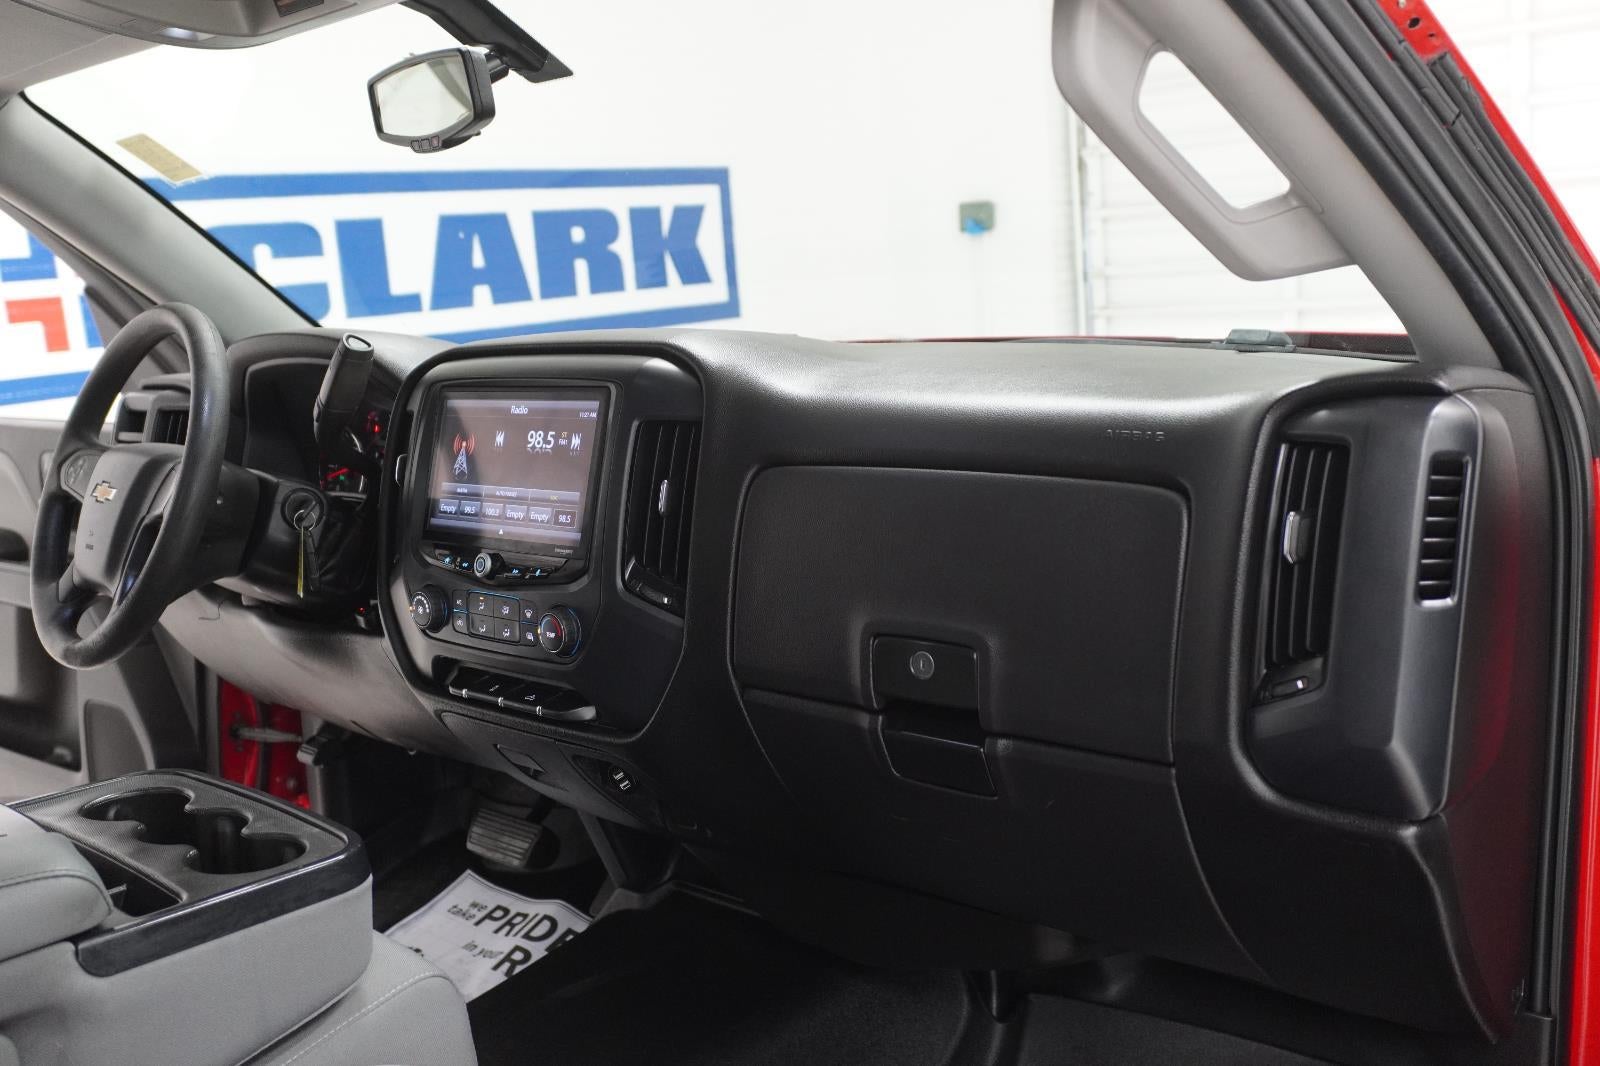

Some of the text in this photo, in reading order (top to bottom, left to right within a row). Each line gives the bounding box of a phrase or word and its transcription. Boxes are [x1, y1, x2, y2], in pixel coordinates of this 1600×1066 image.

[205, 203, 712, 326] CLARK
[511, 405, 528, 414] Radio
[527, 430, 556, 449] 98.5
[440, 503, 457, 514] Empty
[464, 506, 475, 514] 99.5
[506, 510, 525, 521] Empty
[530, 510, 549, 522] Empty
[558, 514, 572, 524] 98.5
[470, 901, 488, 912] we
[448, 904, 476, 921] take
[462, 940, 504, 959] in your
